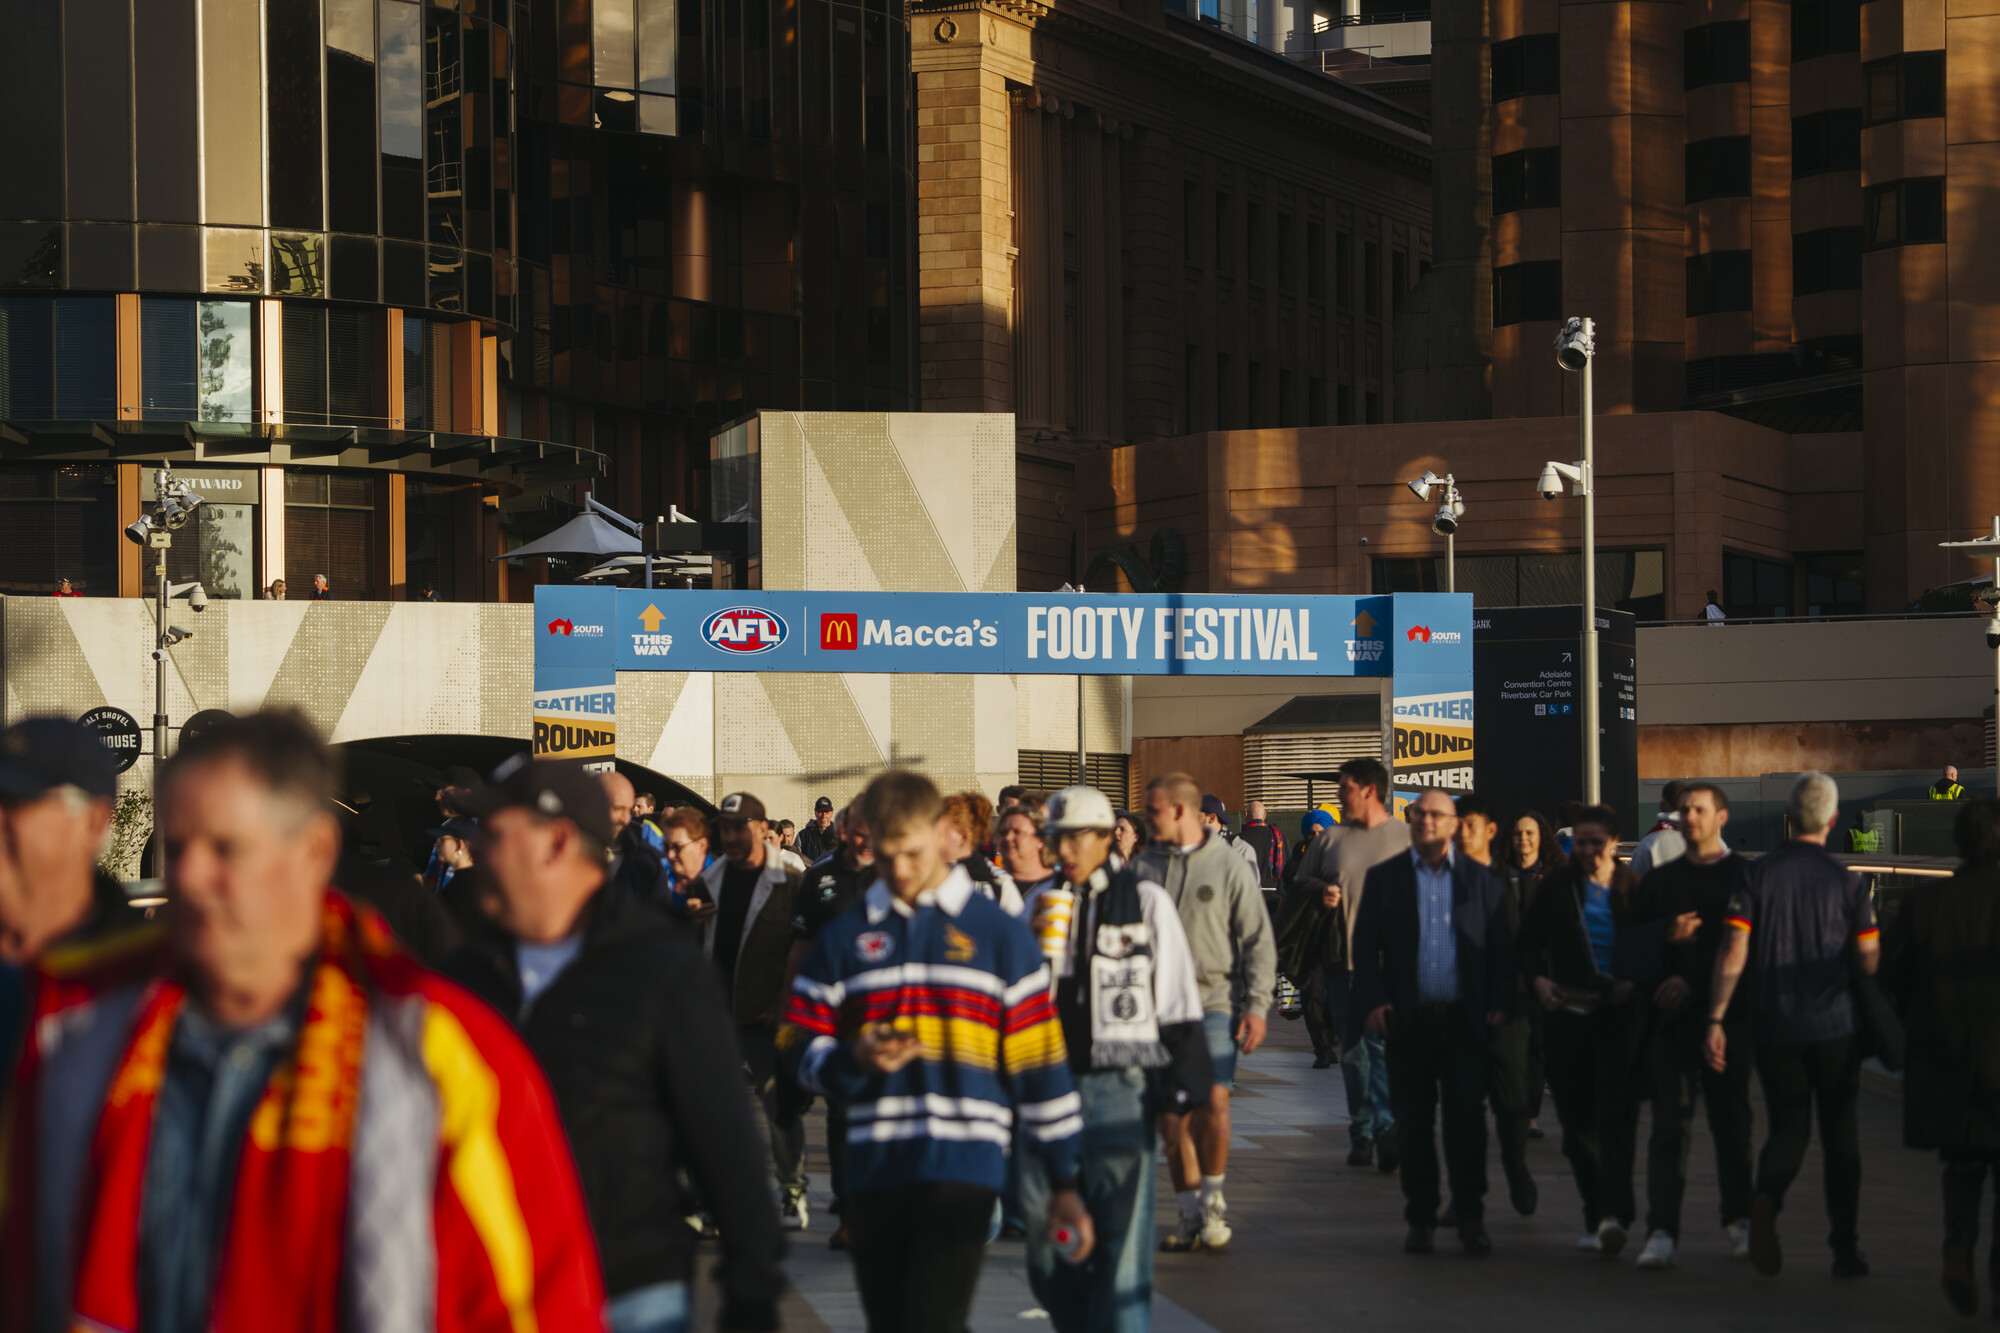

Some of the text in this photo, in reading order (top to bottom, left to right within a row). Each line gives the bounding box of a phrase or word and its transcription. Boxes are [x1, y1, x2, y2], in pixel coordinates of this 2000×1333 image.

[573, 625, 603, 633] SOUTH
[709, 618, 781, 642] AFL
[863, 618, 998, 647] Macca's
[1027, 606, 1318, 661] FOOTY FESTIVAL
[1431, 632, 1461, 640] SOUTH
[631, 634, 673, 645] THIS
[1344, 640, 1385, 651] THIS
[633, 645, 671, 656] WAY
[1346, 650, 1382, 661] WAY
[1503, 680, 1546, 689] Convention
[1501, 691, 1538, 699] Riverbank
[1554, 690, 1572, 698] Park
[534, 692, 616, 715] GATHER
[1393, 698, 1473, 721] GATHER
[101, 711, 129, 727] SHOVEL
[534, 721, 616, 755] ROUND
[1393, 727, 1473, 760] ROUND
[1393, 766, 1474, 790] GATHER
